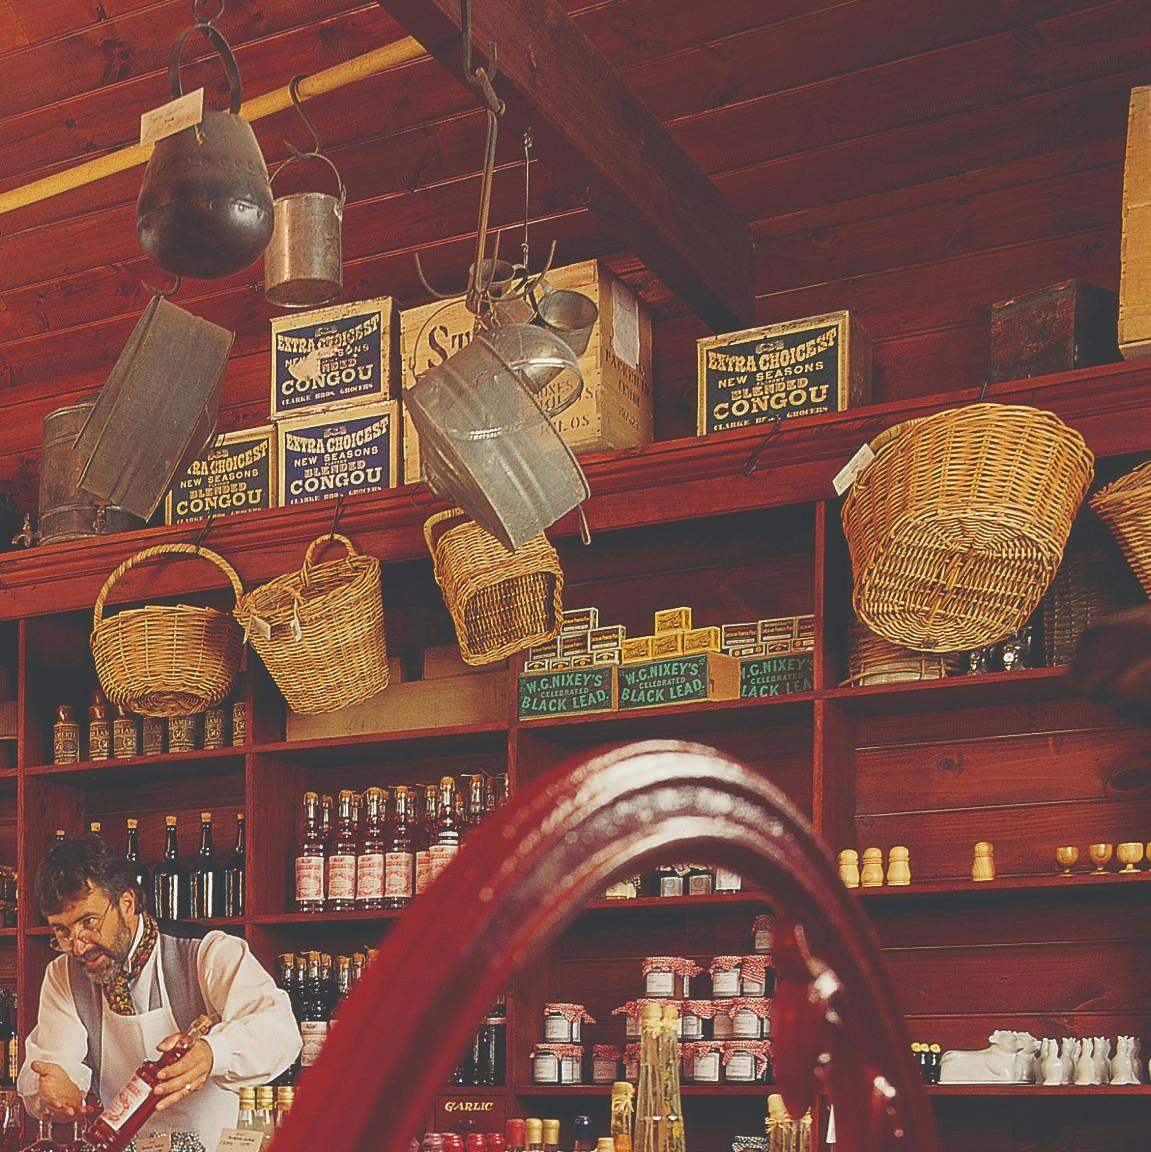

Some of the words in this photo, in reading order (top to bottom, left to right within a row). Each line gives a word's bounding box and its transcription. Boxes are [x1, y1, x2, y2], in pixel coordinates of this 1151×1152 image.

[277, 334, 315, 353] EXTRA
[708, 351, 757, 373] EXTRA
[758, 327, 837, 371] CHOICEST
[281, 364, 374, 395] CONGOU
[718, 375, 747, 389] NEW
[756, 361, 824, 382] SEASONS
[731, 377, 809, 401] BLENDED
[713, 385, 829, 420] CONGOU
[286, 433, 325, 454] EXTRA
[326, 416, 389, 453] CHOICEST
[210, 440, 268, 475] CHOICEST
[294, 456, 317, 467] NEW
[324, 446, 379, 462] SEASONS
[180, 478, 202, 488] NEW
[208, 468, 259, 483] SEASONS
[304, 460, 366, 478] BLENDED
[189, 482, 247, 500] BLENDED
[290, 467, 383, 495] CONGOU
[176, 489, 263, 515] CONGOU
[540, 687, 589, 699] CELEBRATED
[621, 688, 664, 702] BLACK
[670, 678, 706, 699] LEAD.
[639, 677, 686, 690] CELEBRATED
[742, 684, 779, 698] LACK
[786, 679, 812, 695] LEA
[521, 696, 566, 711] BLACK
[572, 690, 609, 708] LEAD.
[445, 1101, 494, 1112] GARLIC
